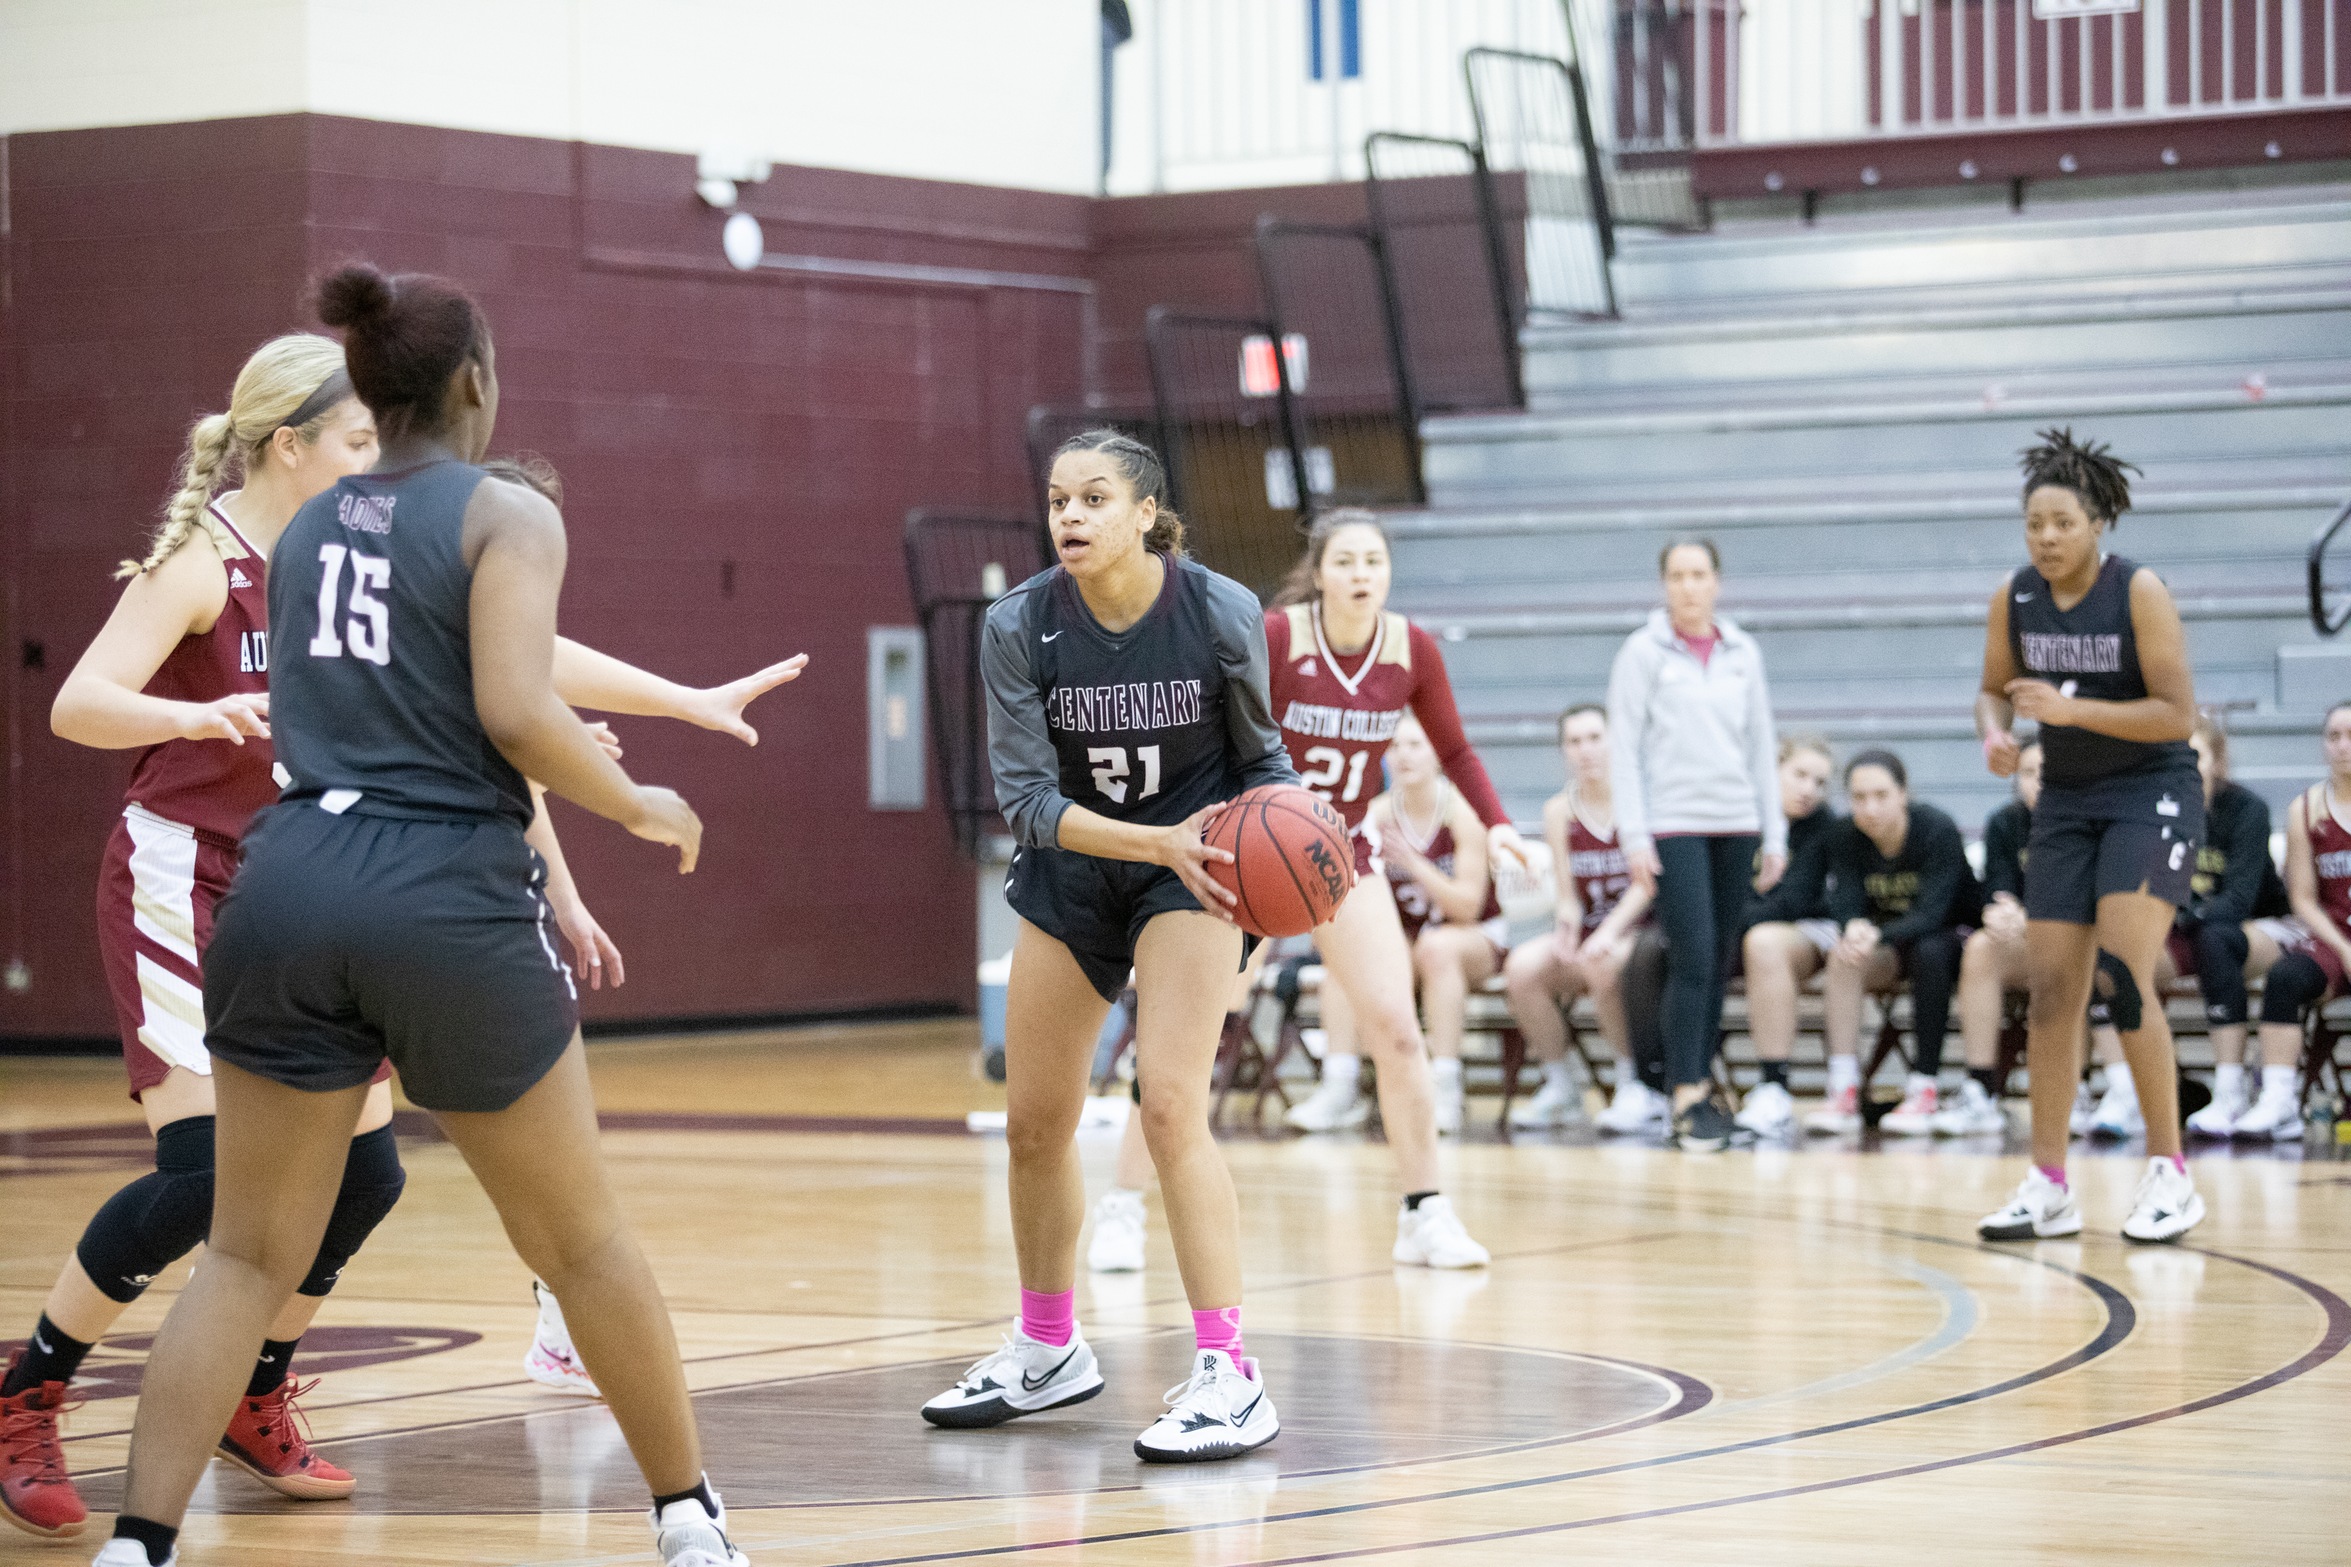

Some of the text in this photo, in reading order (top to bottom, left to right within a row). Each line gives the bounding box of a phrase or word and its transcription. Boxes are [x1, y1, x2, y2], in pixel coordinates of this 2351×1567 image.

[335, 493, 397, 535] ADIES
[310, 543, 392, 667] 15
[1046, 679, 1200, 733] CENTENARY
[1282, 699, 1343, 739] AUSTIN
[1087, 744, 1161, 804] 21
[1301, 745, 1370, 802] 21
